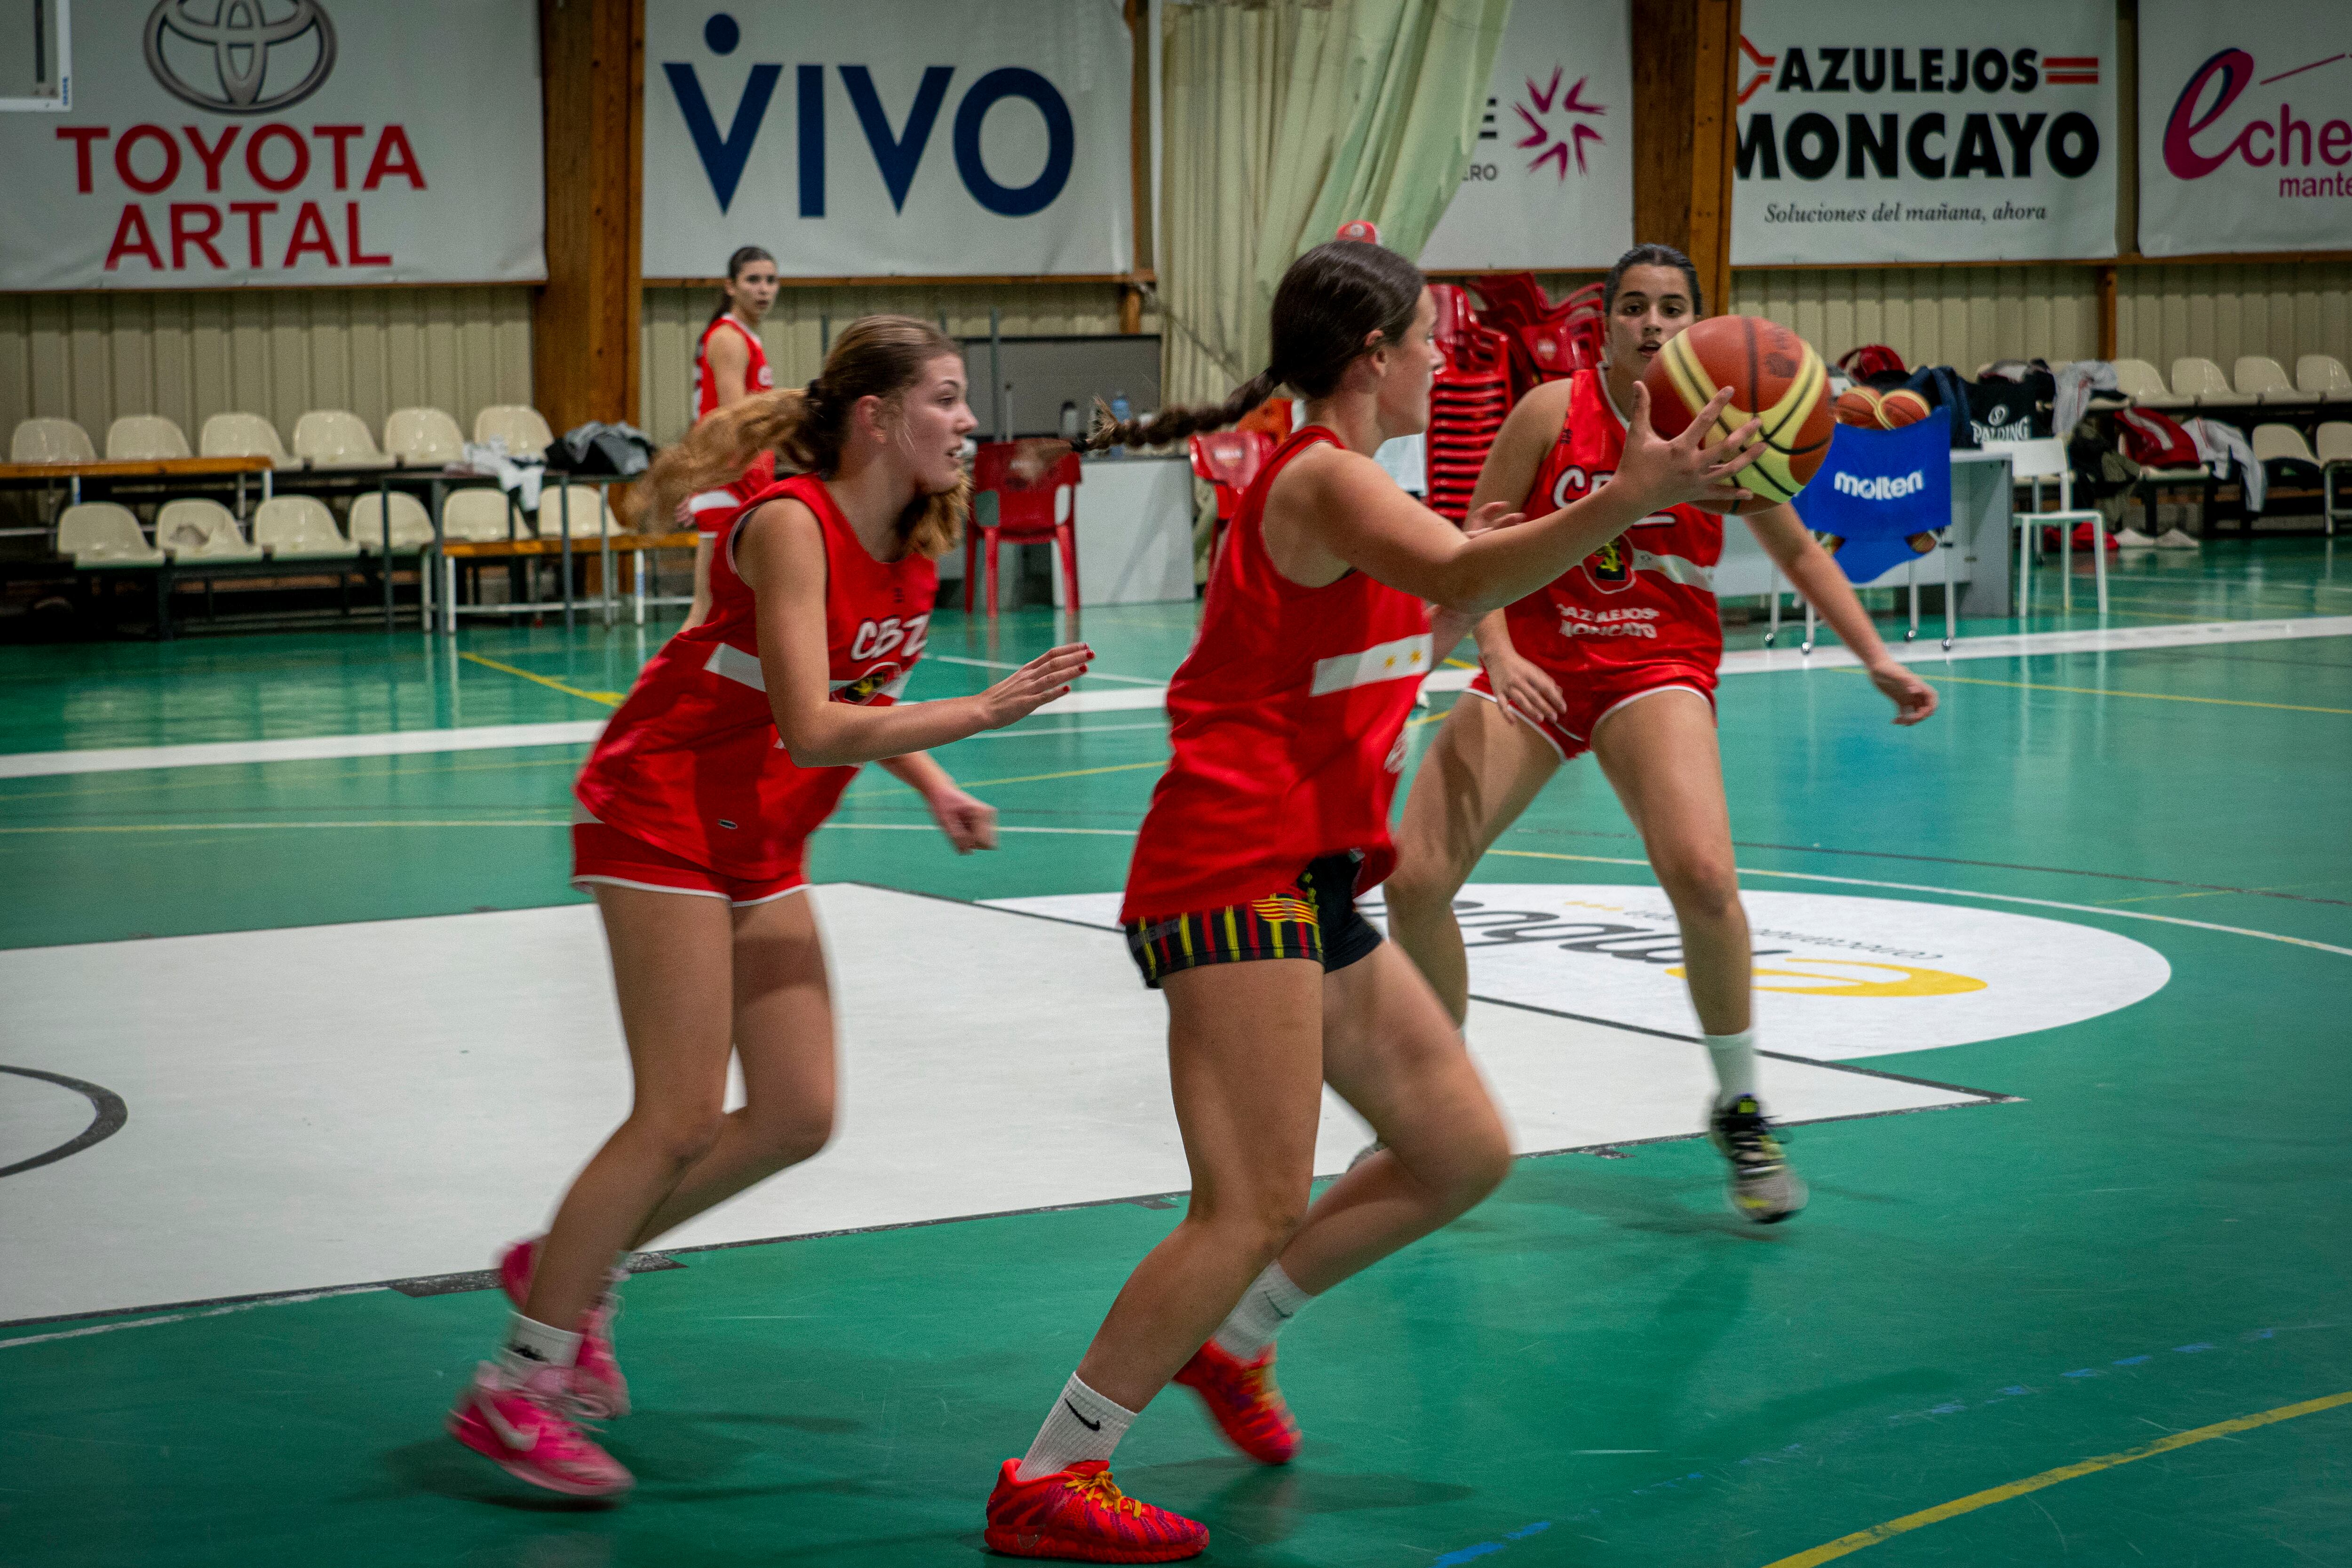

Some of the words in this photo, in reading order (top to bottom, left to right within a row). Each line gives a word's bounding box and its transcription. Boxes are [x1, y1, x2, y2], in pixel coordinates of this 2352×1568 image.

[1776, 48, 2038, 94] AZULEJOS
[56, 123, 427, 194] TOYOTA
[662, 62, 1074, 217] VIVO
[1735, 110, 2099, 180] MONCAYO
[104, 201, 392, 270] ARTAL
[1764, 203, 1866, 223] Soluciones
[1872, 201, 1900, 222] del
[1906, 202, 1986, 224] mañana,
[1992, 200, 2047, 221] ahora
[1834, 470, 1923, 500] molten
[850, 614, 931, 660] CBZ
